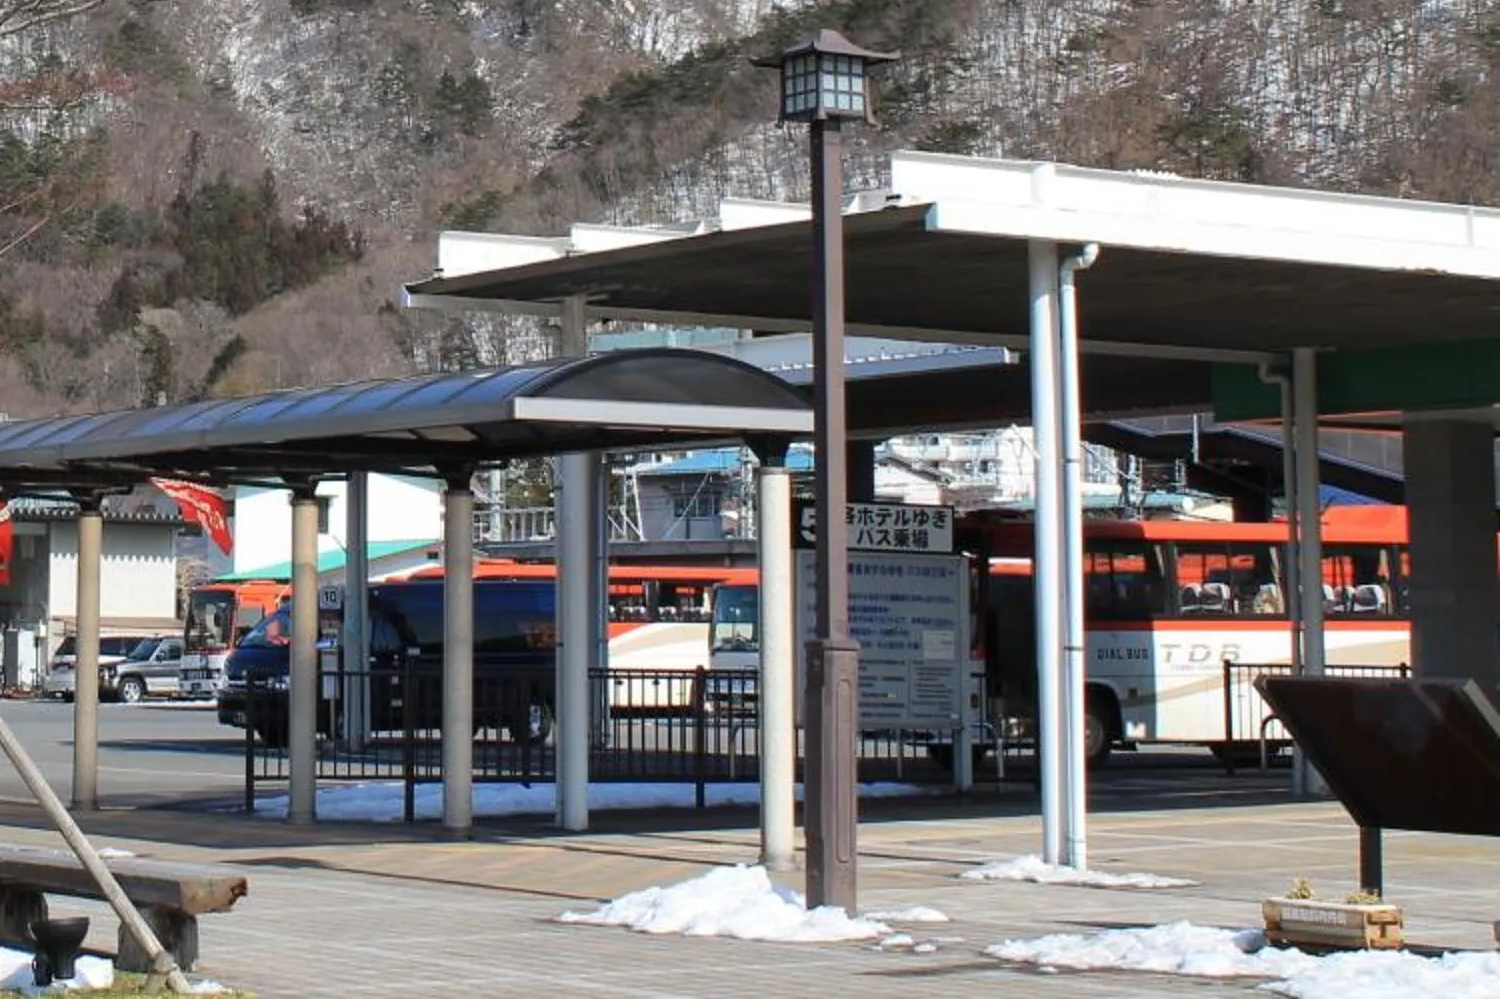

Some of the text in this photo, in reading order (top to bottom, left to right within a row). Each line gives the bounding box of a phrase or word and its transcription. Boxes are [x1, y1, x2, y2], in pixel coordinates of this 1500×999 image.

[857, 528, 929, 549] バス乗場
[324, 590, 337, 603] 10
[1097, 648, 1150, 660] DIAL BUS
[1160, 643, 1241, 663] TDB
